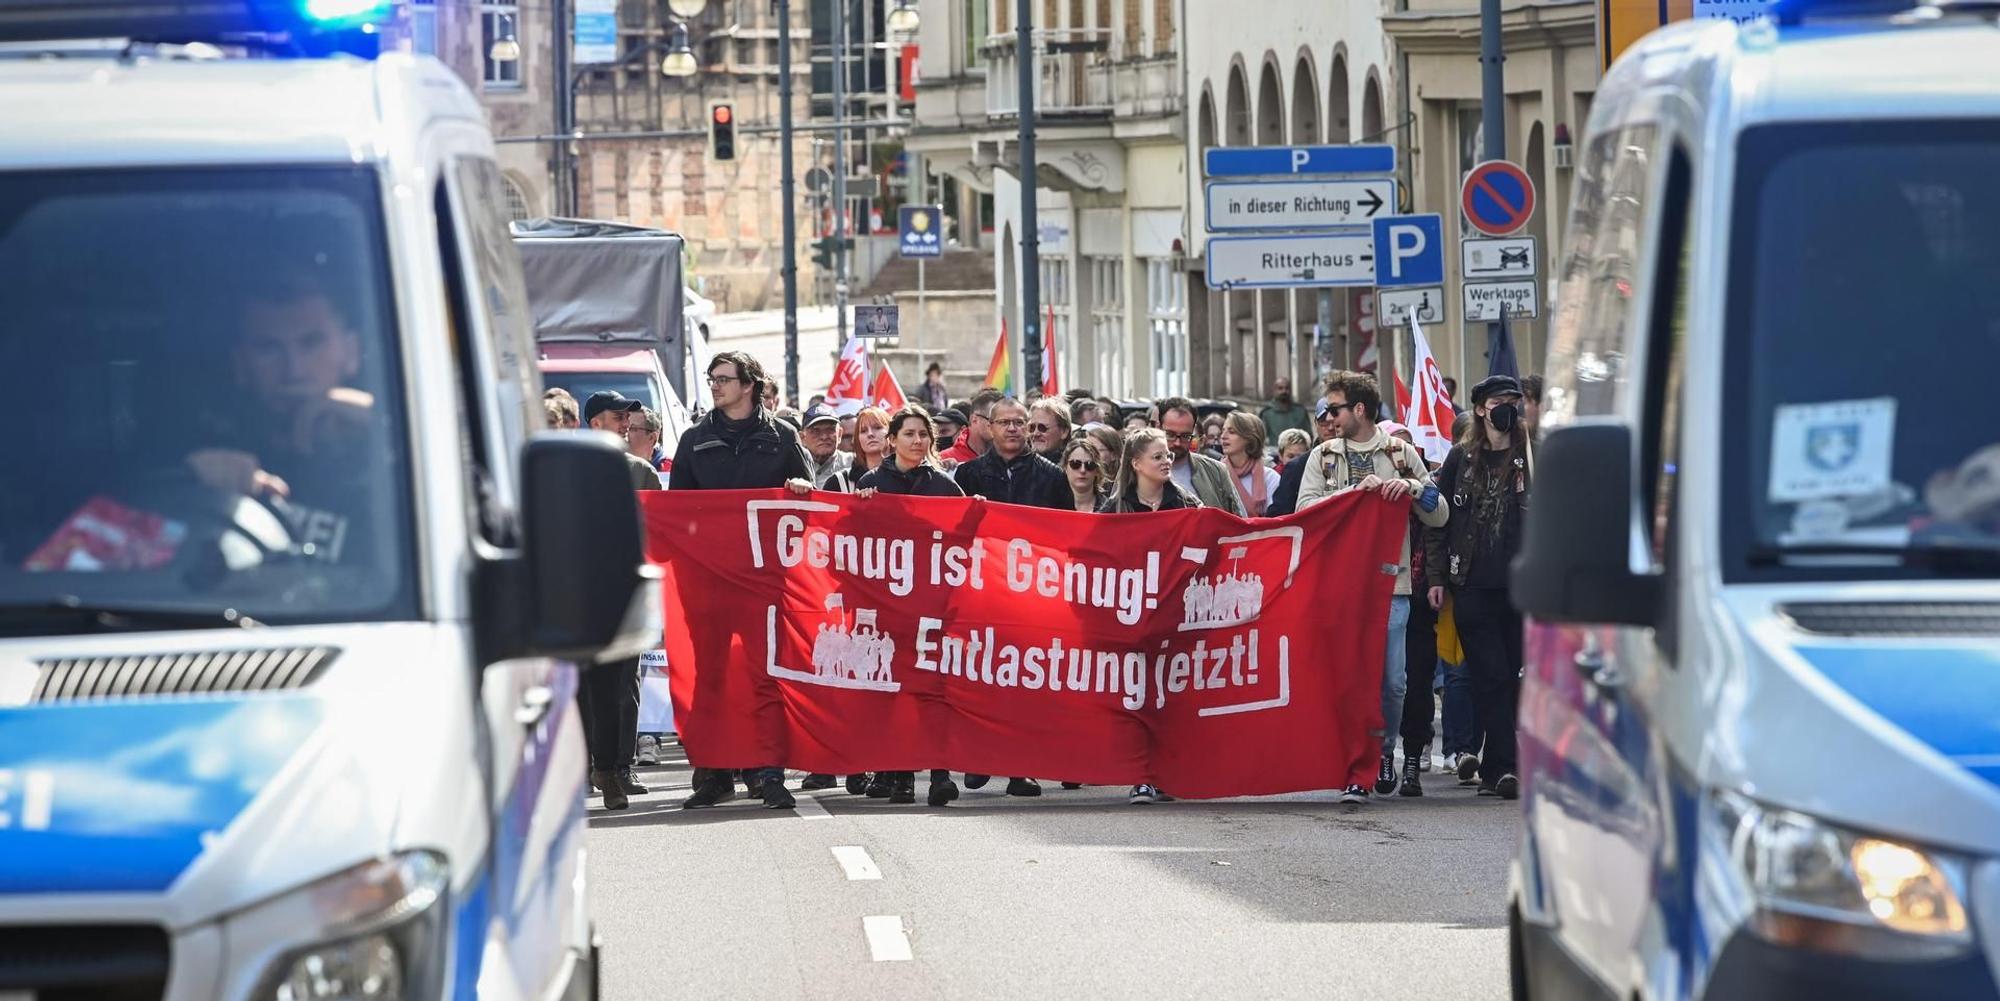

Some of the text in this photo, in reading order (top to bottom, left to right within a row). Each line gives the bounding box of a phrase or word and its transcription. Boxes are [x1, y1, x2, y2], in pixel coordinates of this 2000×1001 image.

[1291, 149, 1310, 173] P
[1228, 197, 1351, 215] in dieser Richtung
[1262, 252, 1354, 269] Ritterhaus
[1389, 224, 1426, 278] P
[1470, 287, 1531, 301] Werktags
[776, 514, 1160, 626] Genug ist Genug!
[914, 616, 1259, 711] Entlastung jetzt!
